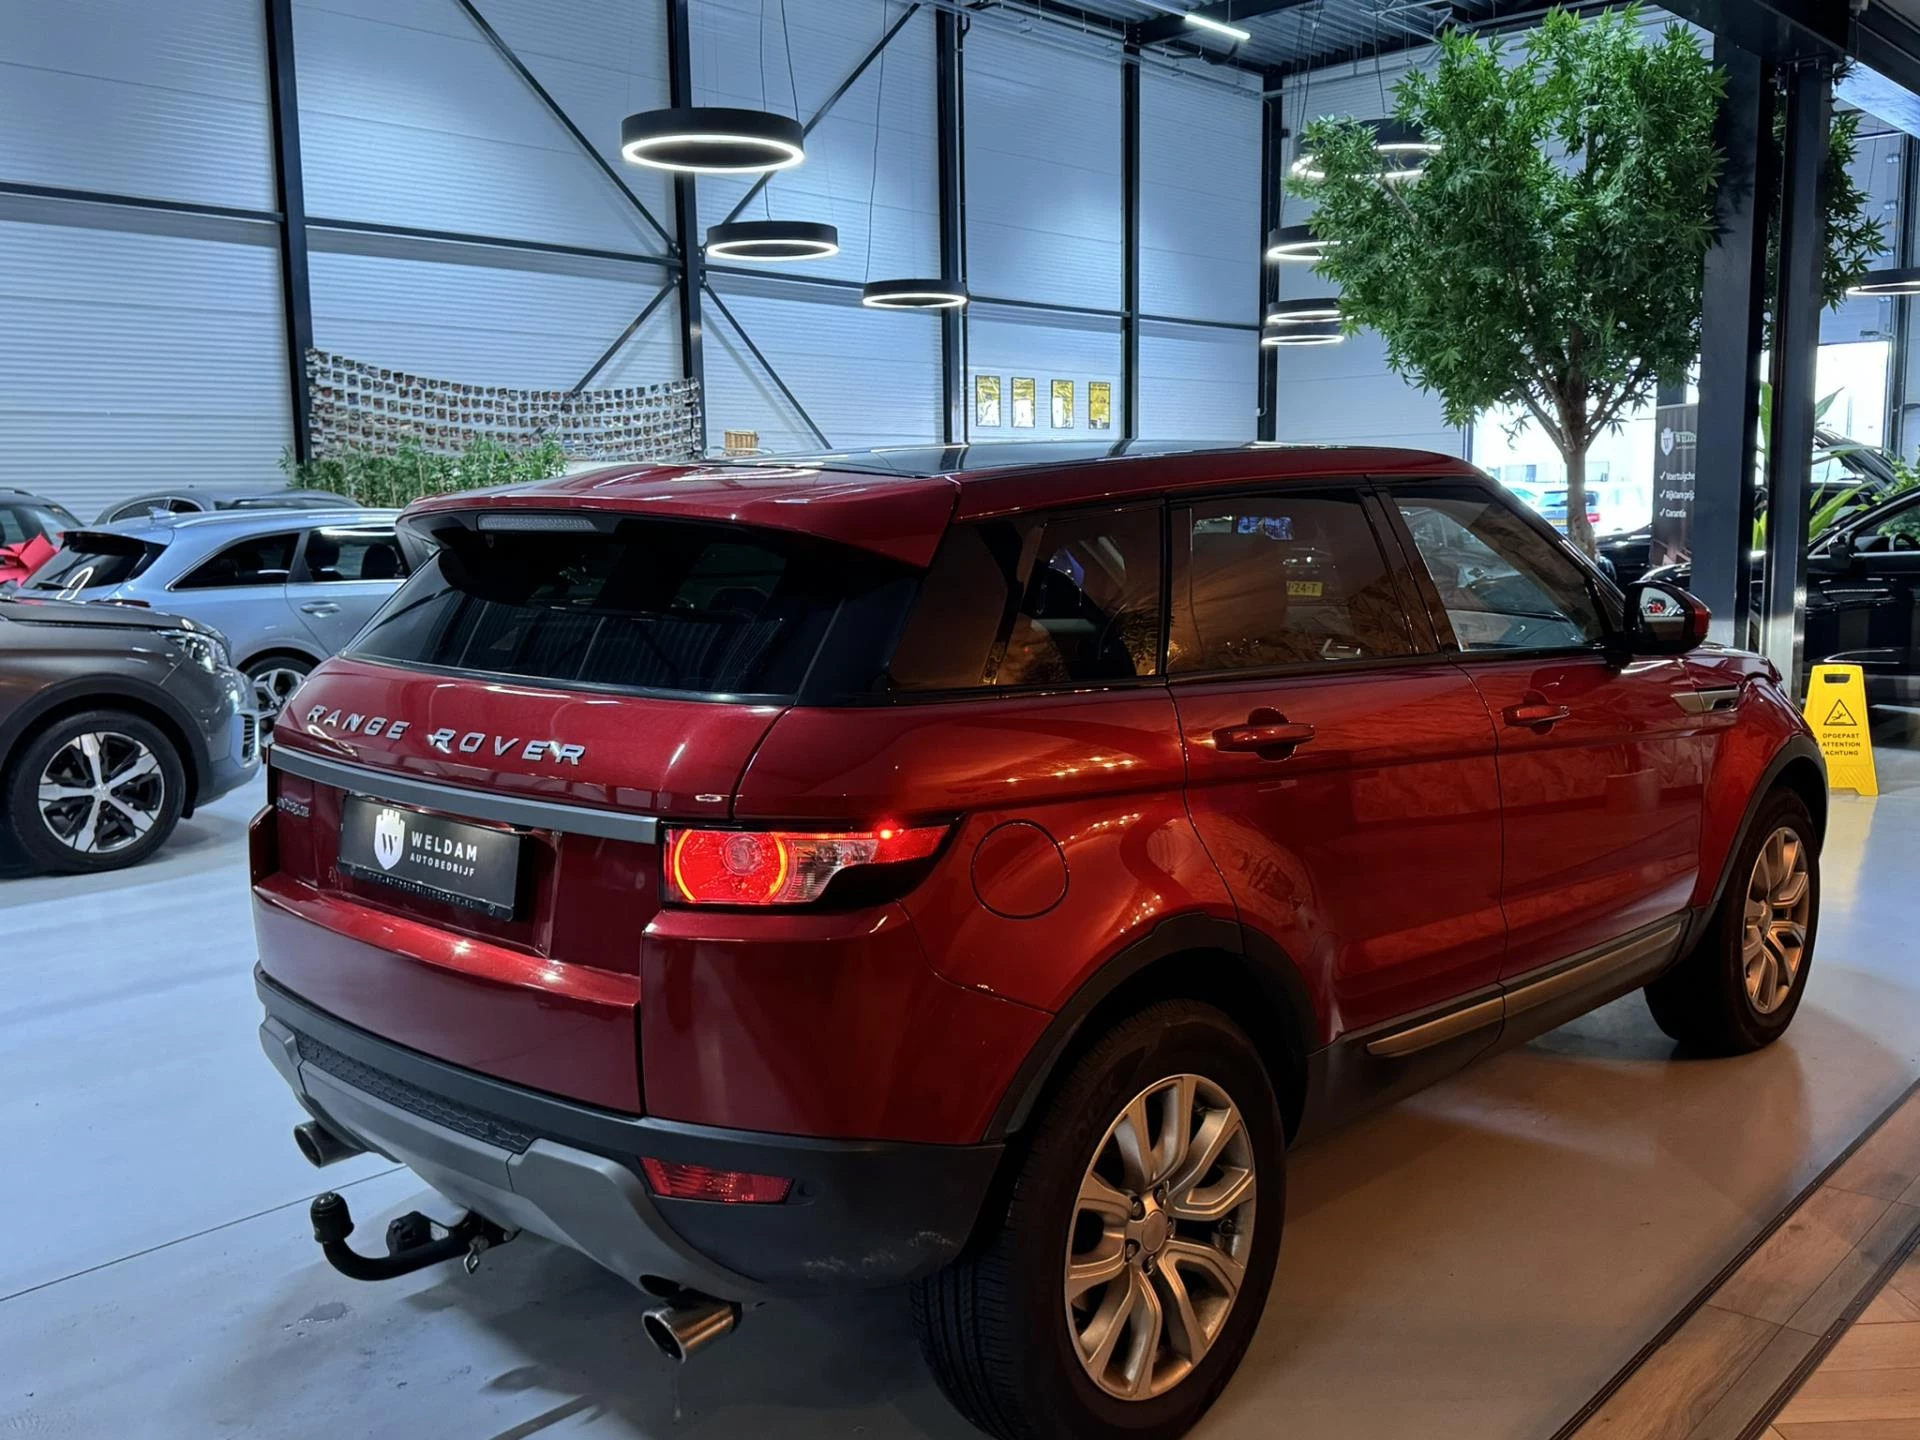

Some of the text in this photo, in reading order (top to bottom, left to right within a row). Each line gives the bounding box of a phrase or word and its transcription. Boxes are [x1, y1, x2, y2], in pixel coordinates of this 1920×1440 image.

[306, 704, 586, 765] RANGE ROVER
[410, 831, 478, 862] WELDAM
[409, 853, 476, 877] AUTOBEDRIJF
